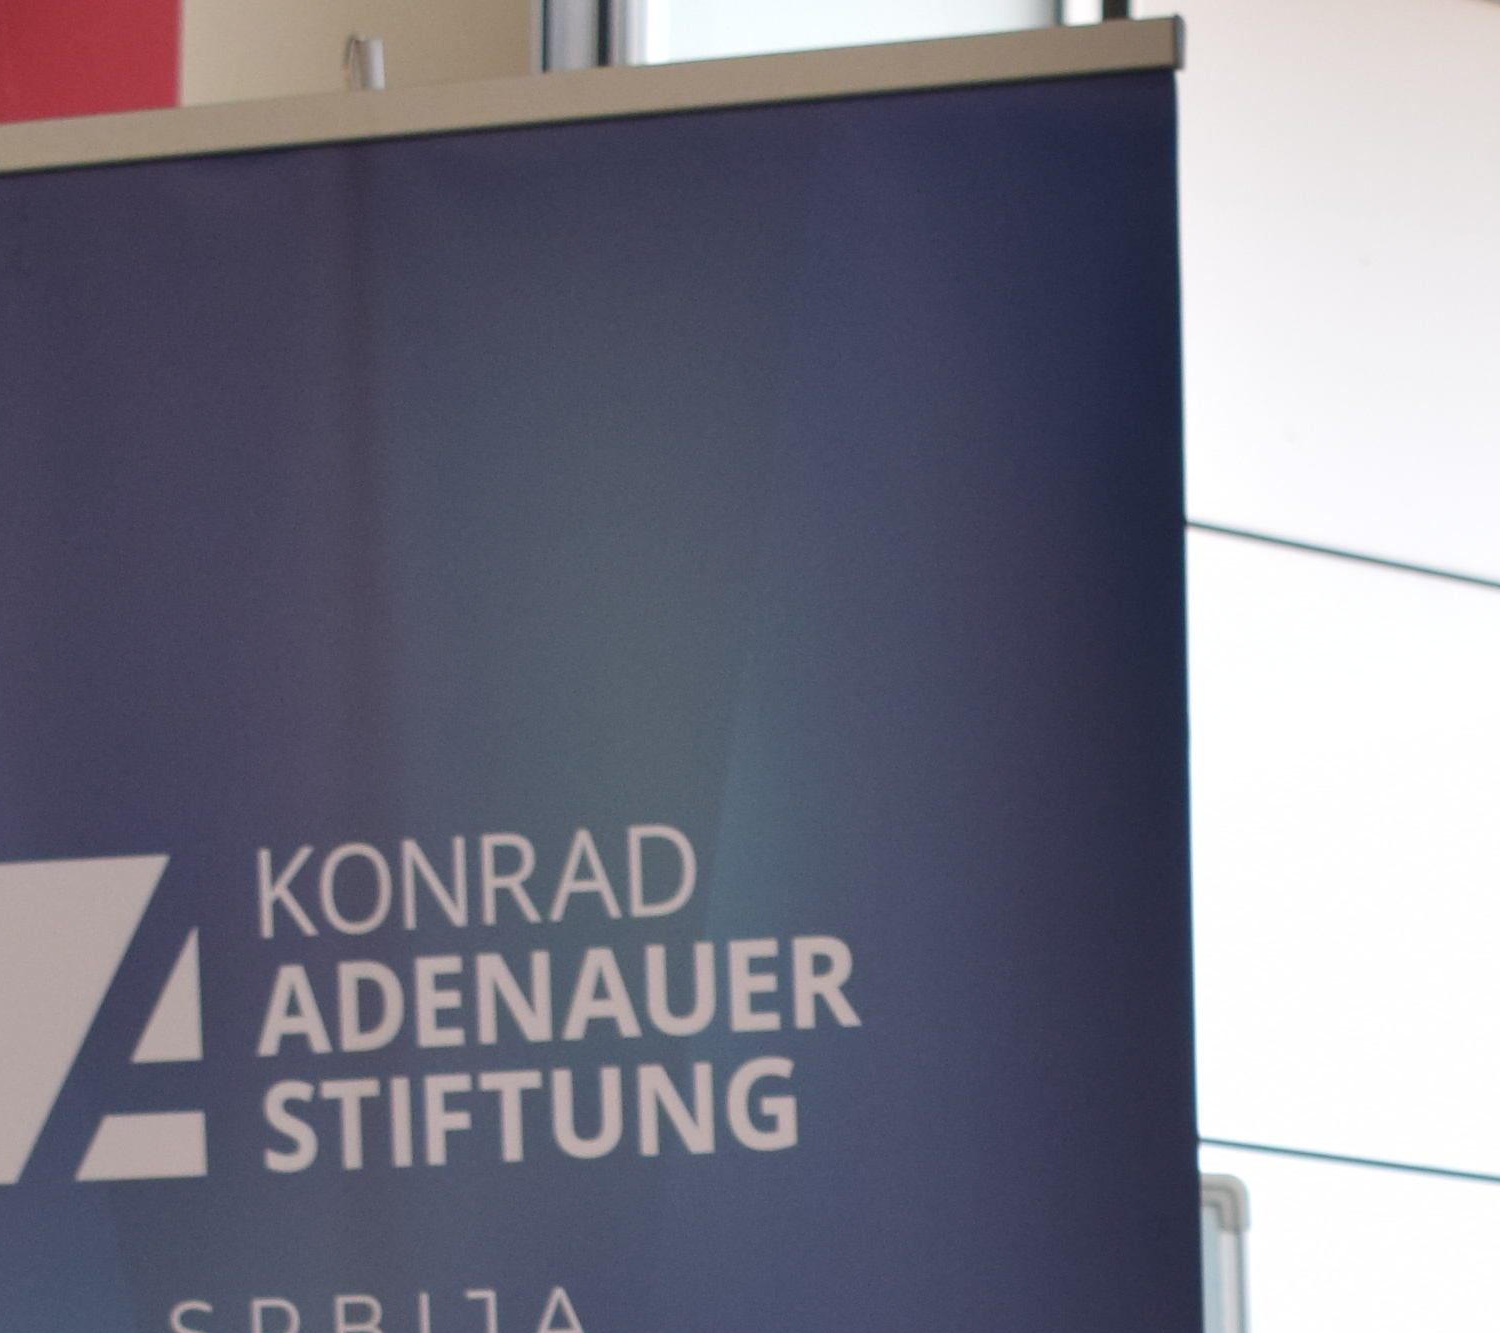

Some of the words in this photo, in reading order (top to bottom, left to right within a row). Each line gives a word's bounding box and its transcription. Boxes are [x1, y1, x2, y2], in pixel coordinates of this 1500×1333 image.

[256, 823, 698, 940] KONRAD
[255, 935, 862, 1058] ADENAUER
[262, 1056, 799, 1174] STIFTUNG
